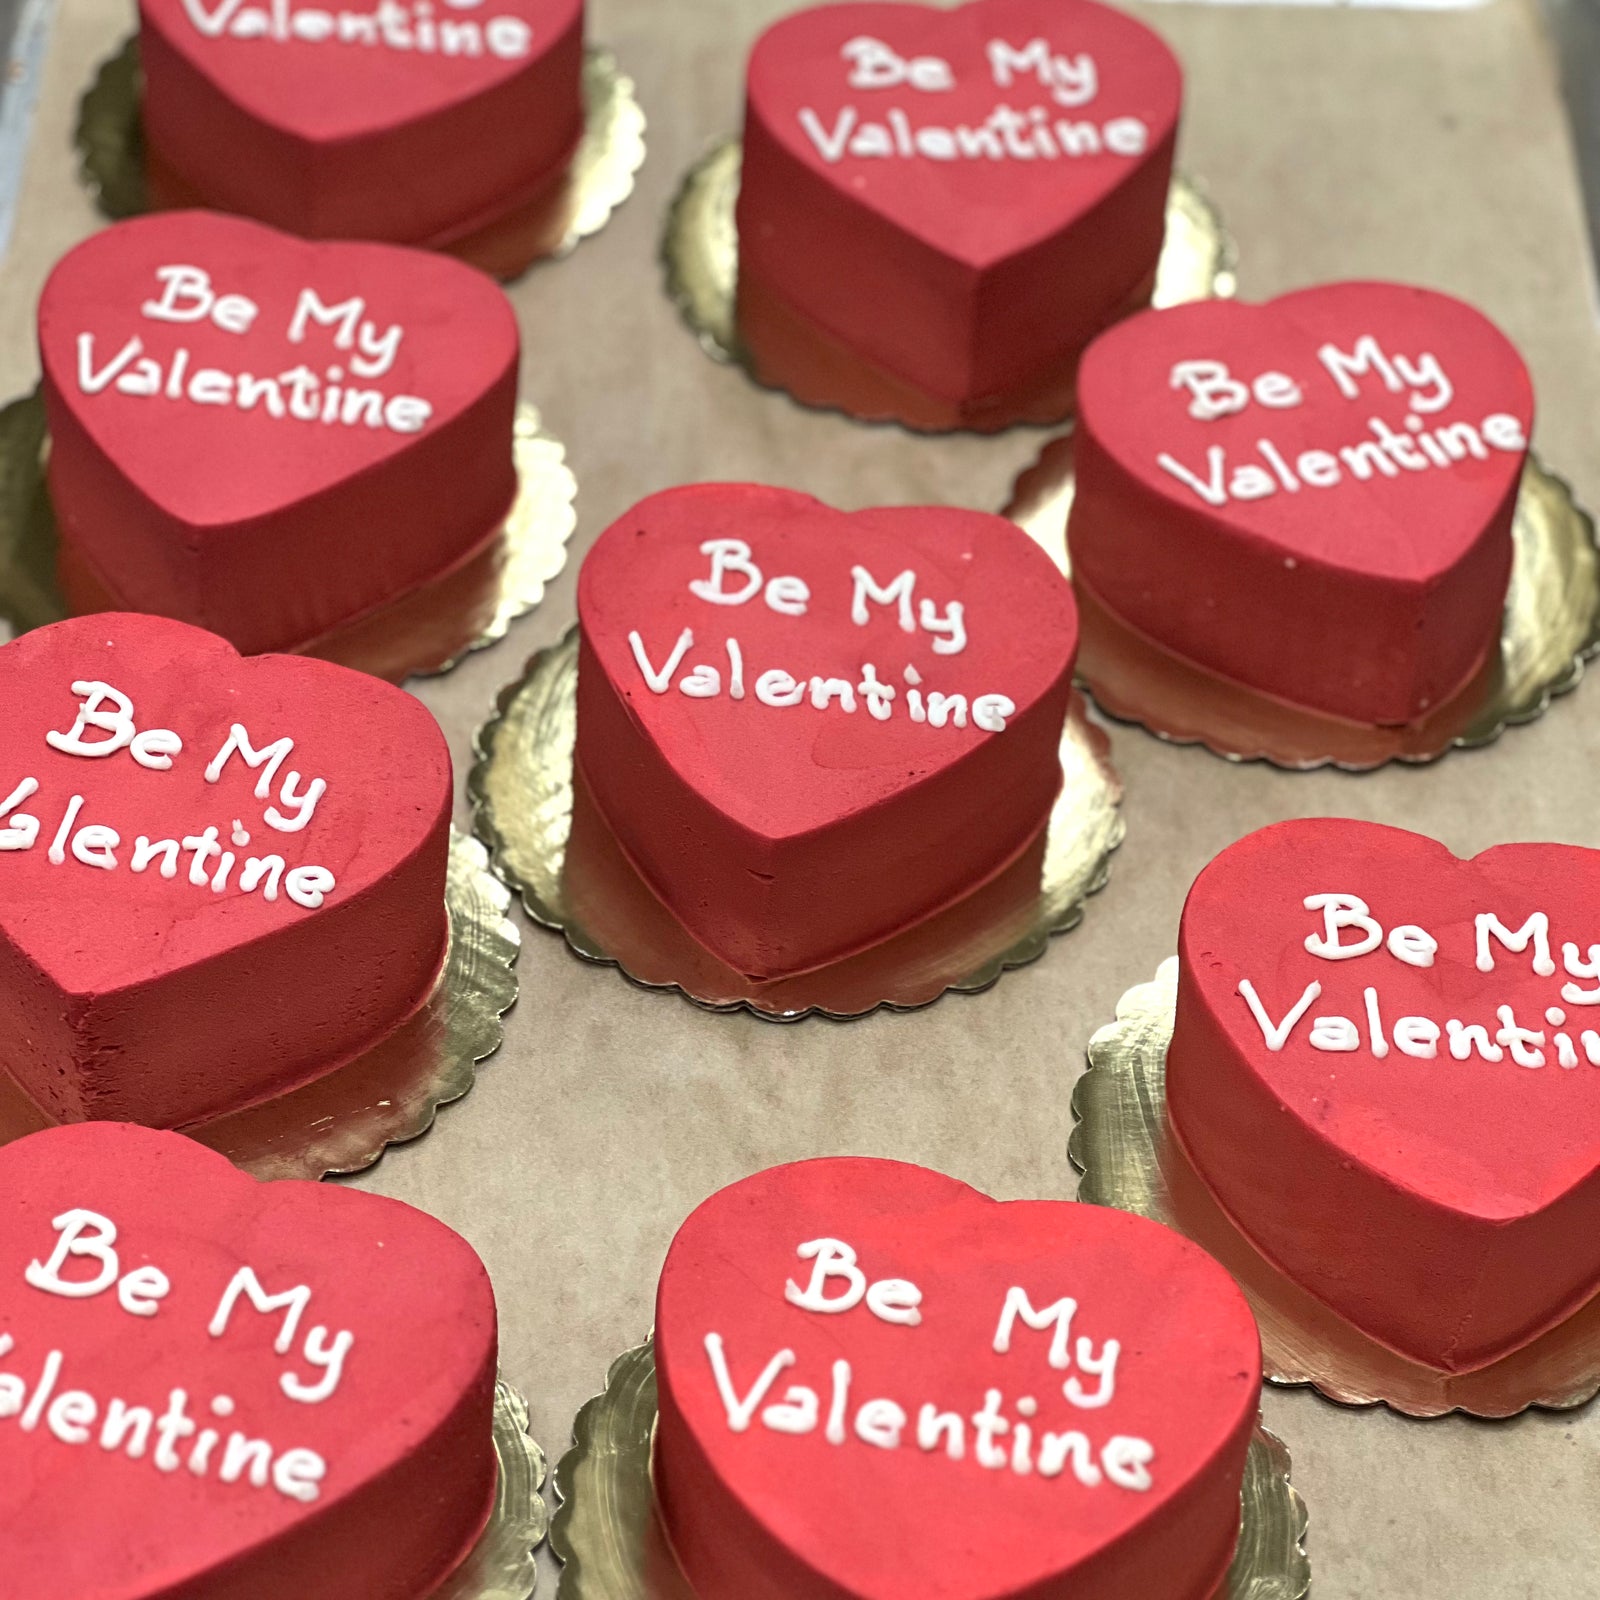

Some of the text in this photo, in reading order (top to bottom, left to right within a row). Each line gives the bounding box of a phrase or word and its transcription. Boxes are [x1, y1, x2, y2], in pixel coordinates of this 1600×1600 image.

[842, 36, 1098, 106] Be My
[798, 105, 1149, 162] Valentine
[141, 264, 404, 378] Be My
[1169, 334, 1454, 420] Be My
[76, 332, 433, 433] Valentine
[1156, 412, 1527, 505] Valentine
[688, 538, 967, 655] Be My
[628, 627, 1016, 733] Valentine
[45, 680, 327, 833] Be My
[1303, 893, 1600, 1005] Be My
[24, 1208, 354, 1403] Be My
[784, 1237, 1121, 1409] Be My
[0, 1331, 326, 1503] alentine
[703, 1332, 1154, 1492] Valentine
